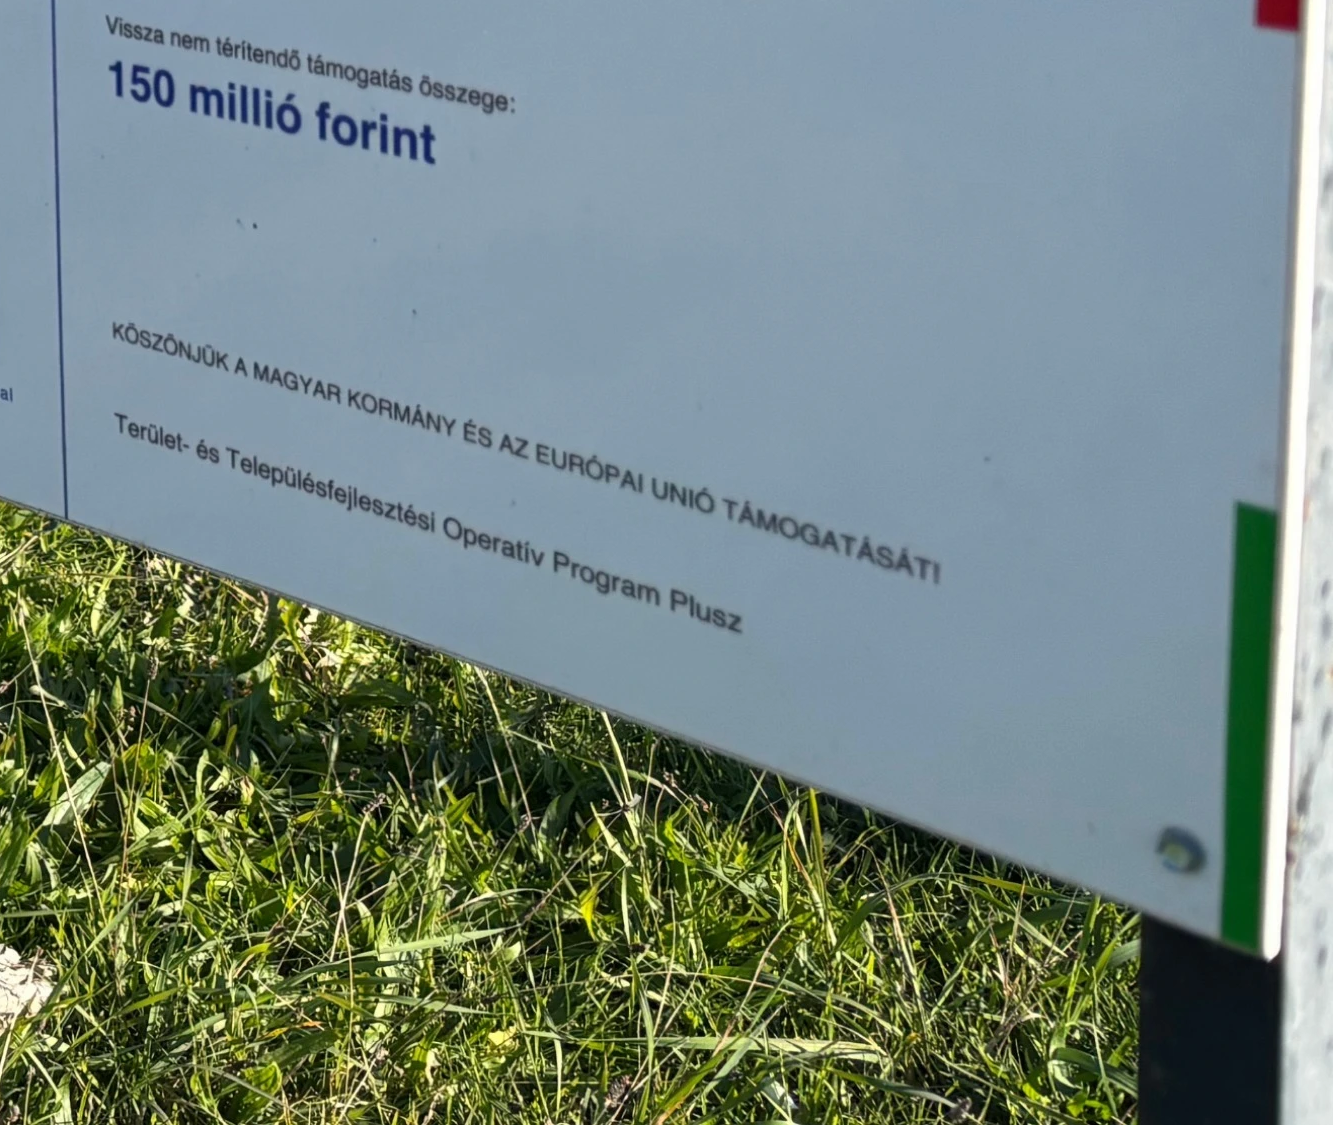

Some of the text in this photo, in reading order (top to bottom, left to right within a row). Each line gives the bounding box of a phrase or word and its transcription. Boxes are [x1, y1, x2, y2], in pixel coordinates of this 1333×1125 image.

[105, 15, 515, 115] Vissza nem térítendő támogatás összege:
[108, 60, 436, 166] 150 millió forint
[113, 322, 229, 372] KÖSZÖNJÜK
[234, 357, 248, 377] A
[254, 362, 341, 404] MAGYAR
[348, 389, 456, 436] KORMÁNY
[463, 419, 492, 448] ÉS
[499, 434, 529, 459] AZ
[536, 443, 643, 493] EURÓPAI
[652, 478, 715, 514] UNIÓ
[114, 413, 742, 634] Terület- és Településfejlesztési Operatív Program Plusz
